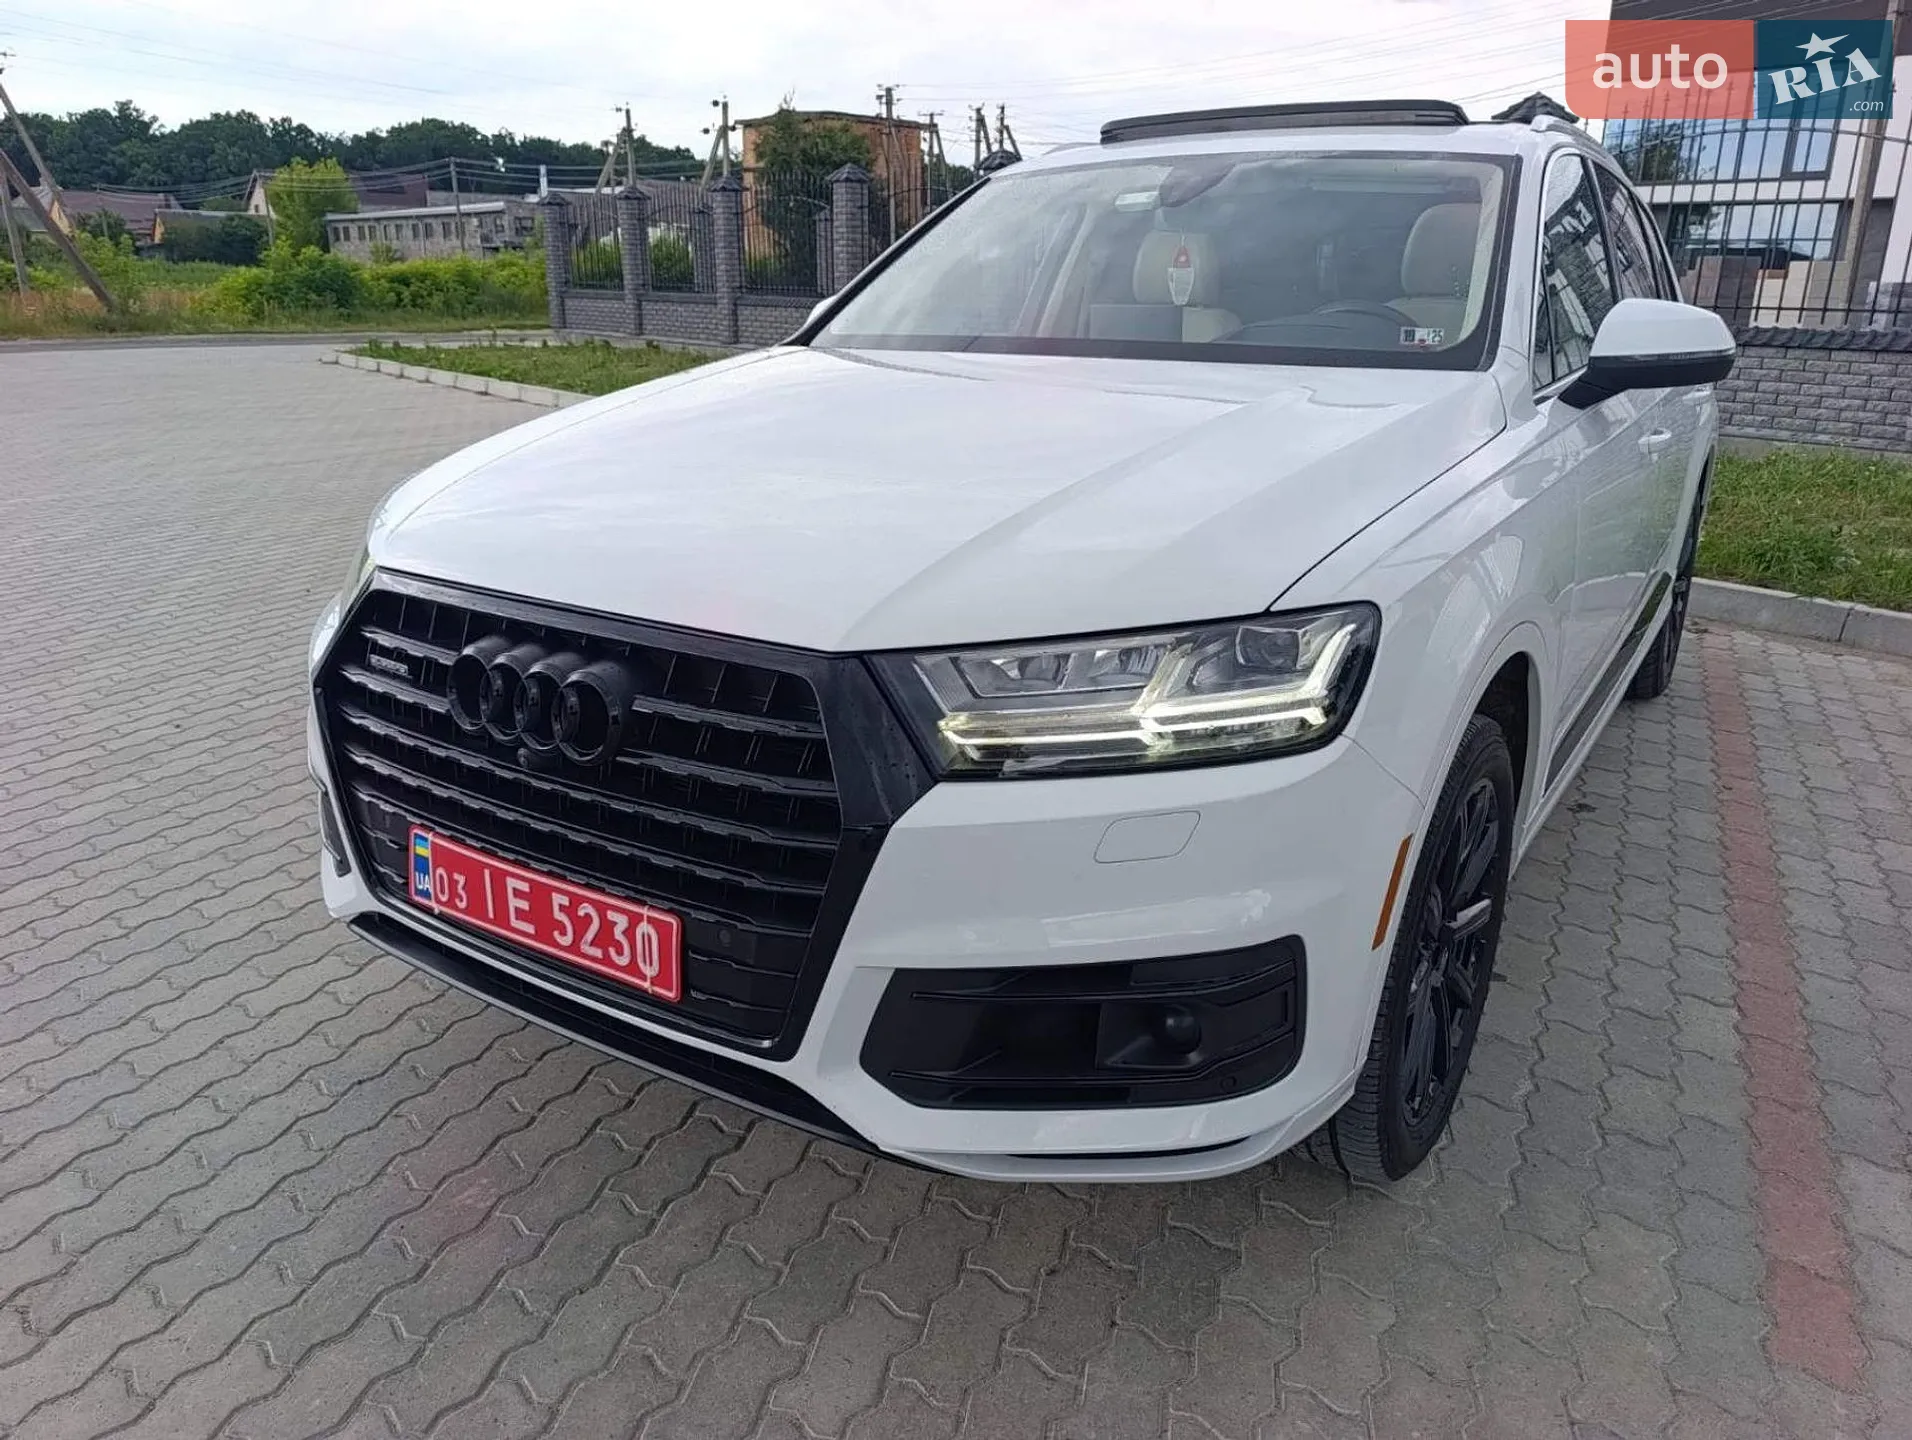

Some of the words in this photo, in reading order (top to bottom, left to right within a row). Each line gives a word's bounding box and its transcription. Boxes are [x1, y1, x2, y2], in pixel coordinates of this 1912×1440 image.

[415, 871, 431, 892] UA
[435, 867, 467, 909] 03
[484, 868, 535, 934] IE
[552, 892, 660, 977] 5230
